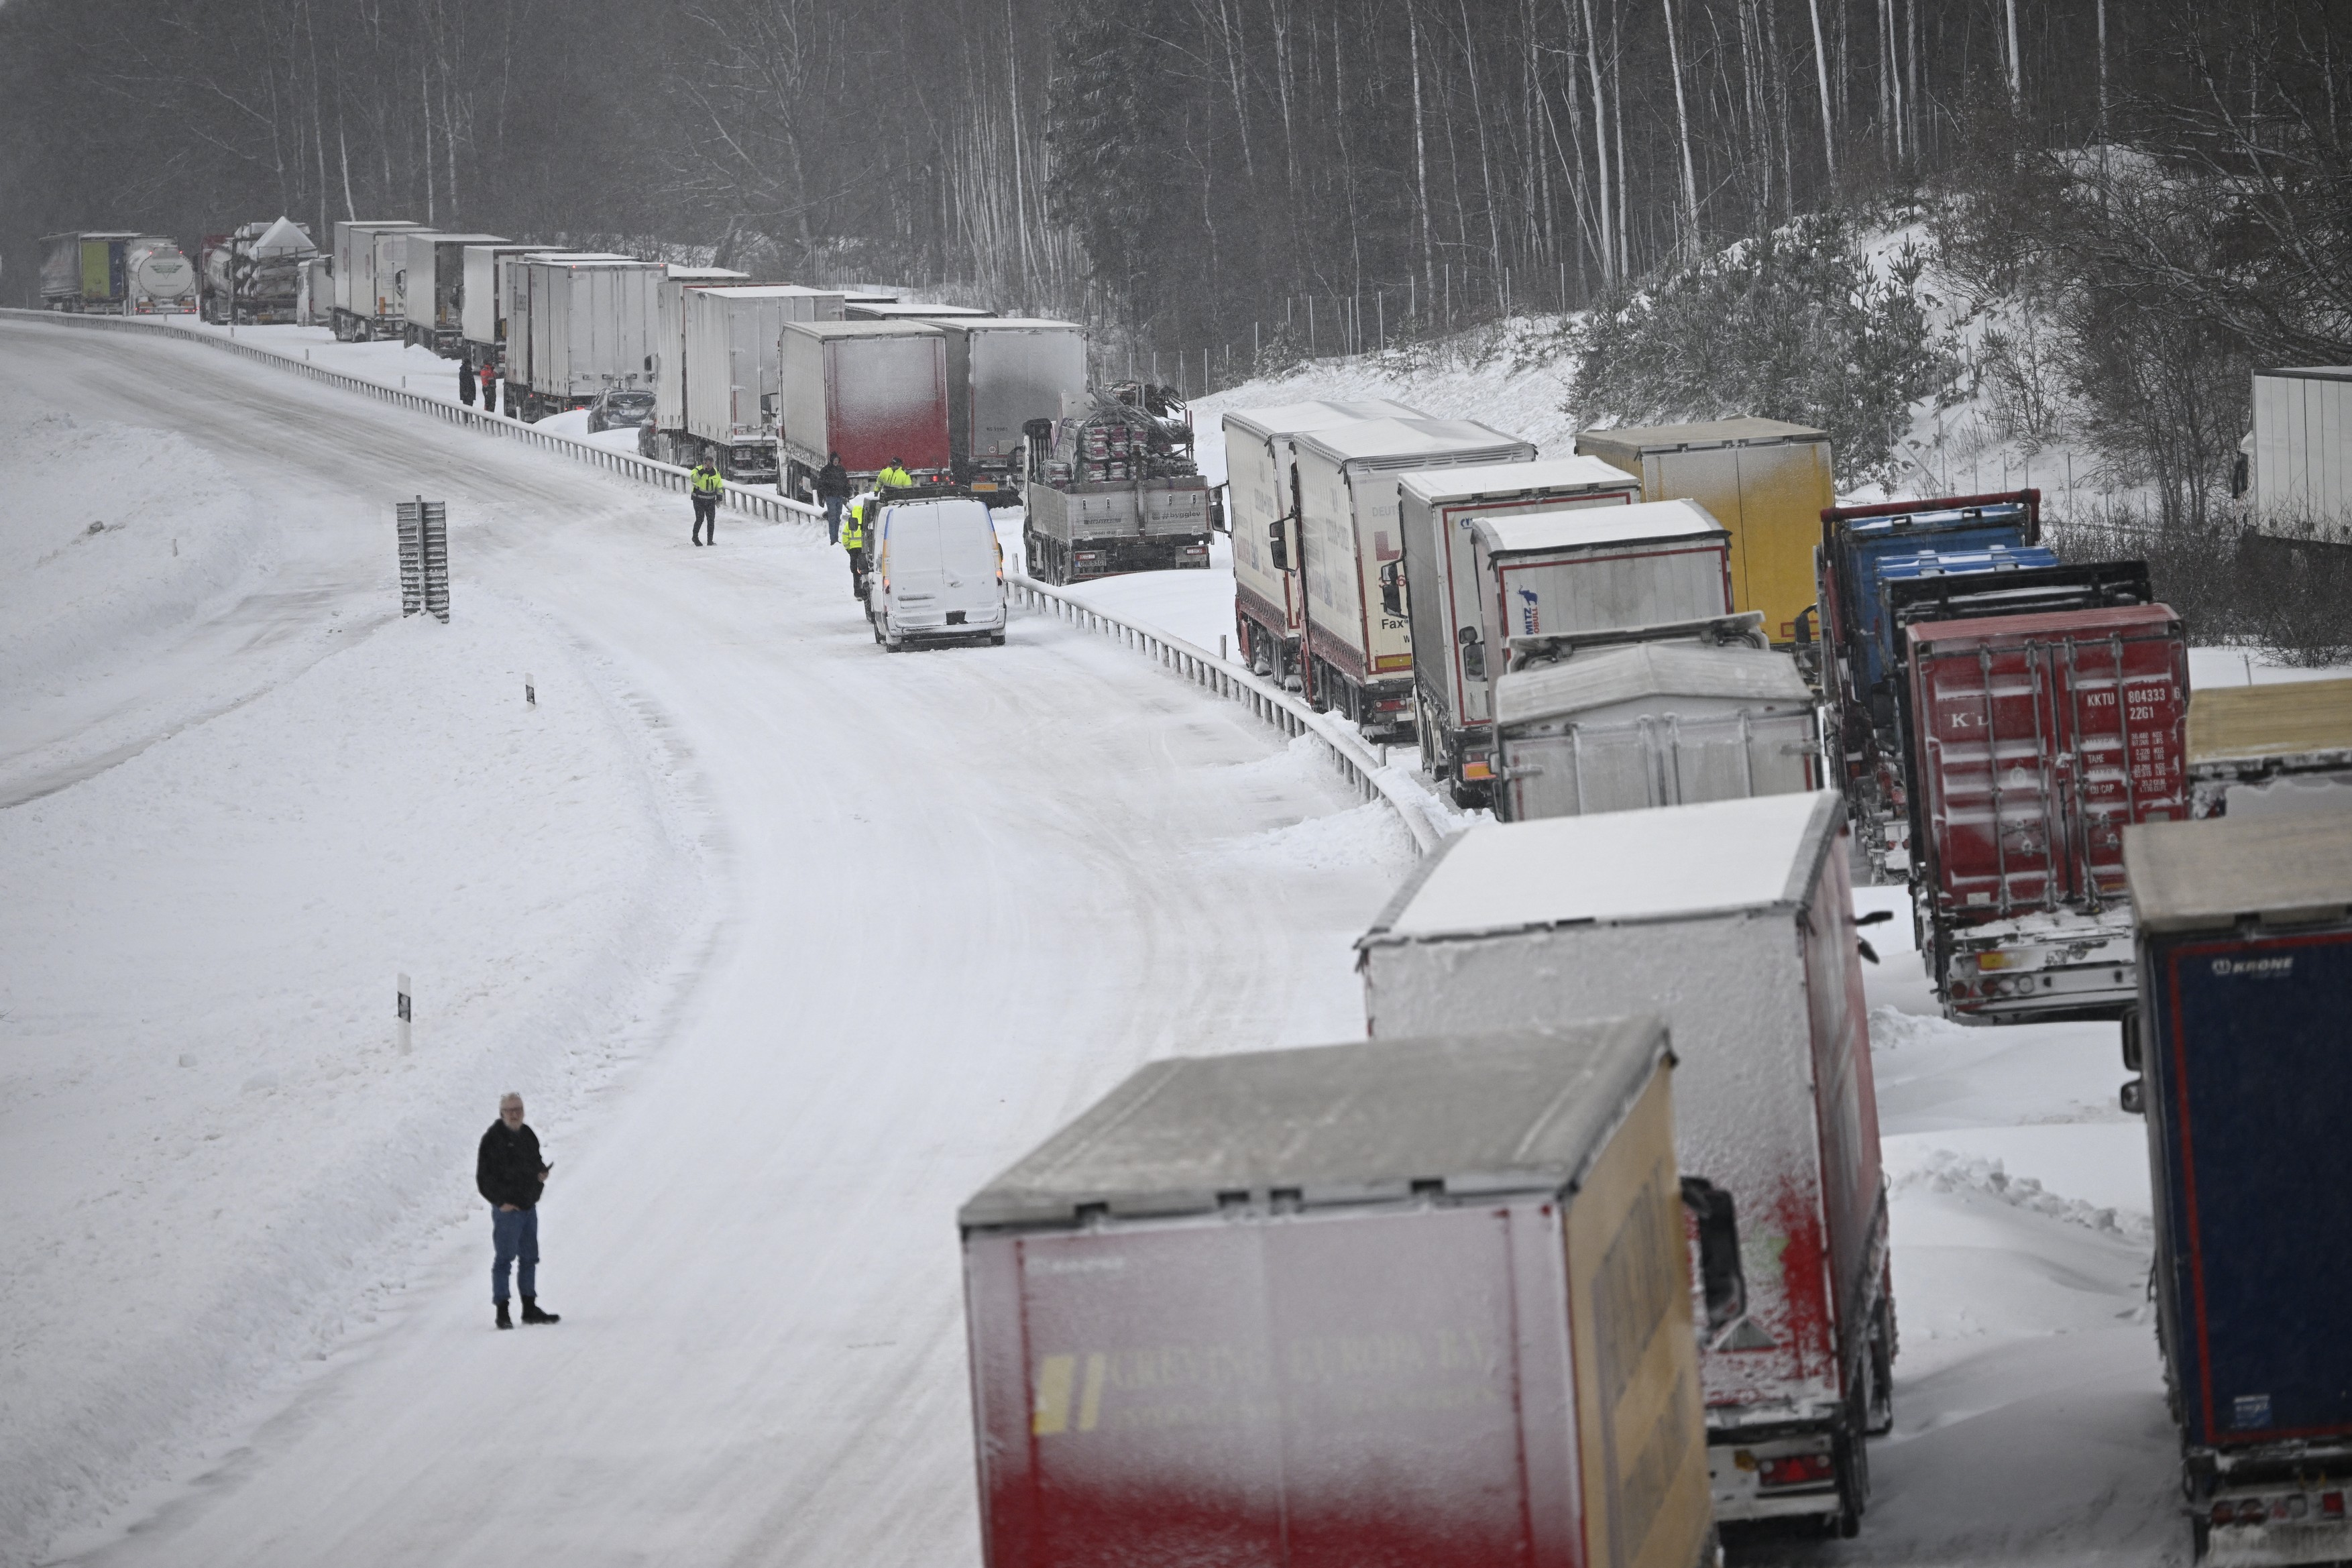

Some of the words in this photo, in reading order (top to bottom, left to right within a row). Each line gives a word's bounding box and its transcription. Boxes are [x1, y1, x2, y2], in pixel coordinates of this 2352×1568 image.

[1162, 511, 1200, 519] #bygglev
[1382, 619, 1404, 630] Fax
[2087, 692, 2115, 707] KKTU
[2128, 688, 2166, 704] 804333
[2174, 687, 2181, 700] 6
[2130, 706, 2154, 720] 22G1
[2088, 754, 2105, 764] TARE
